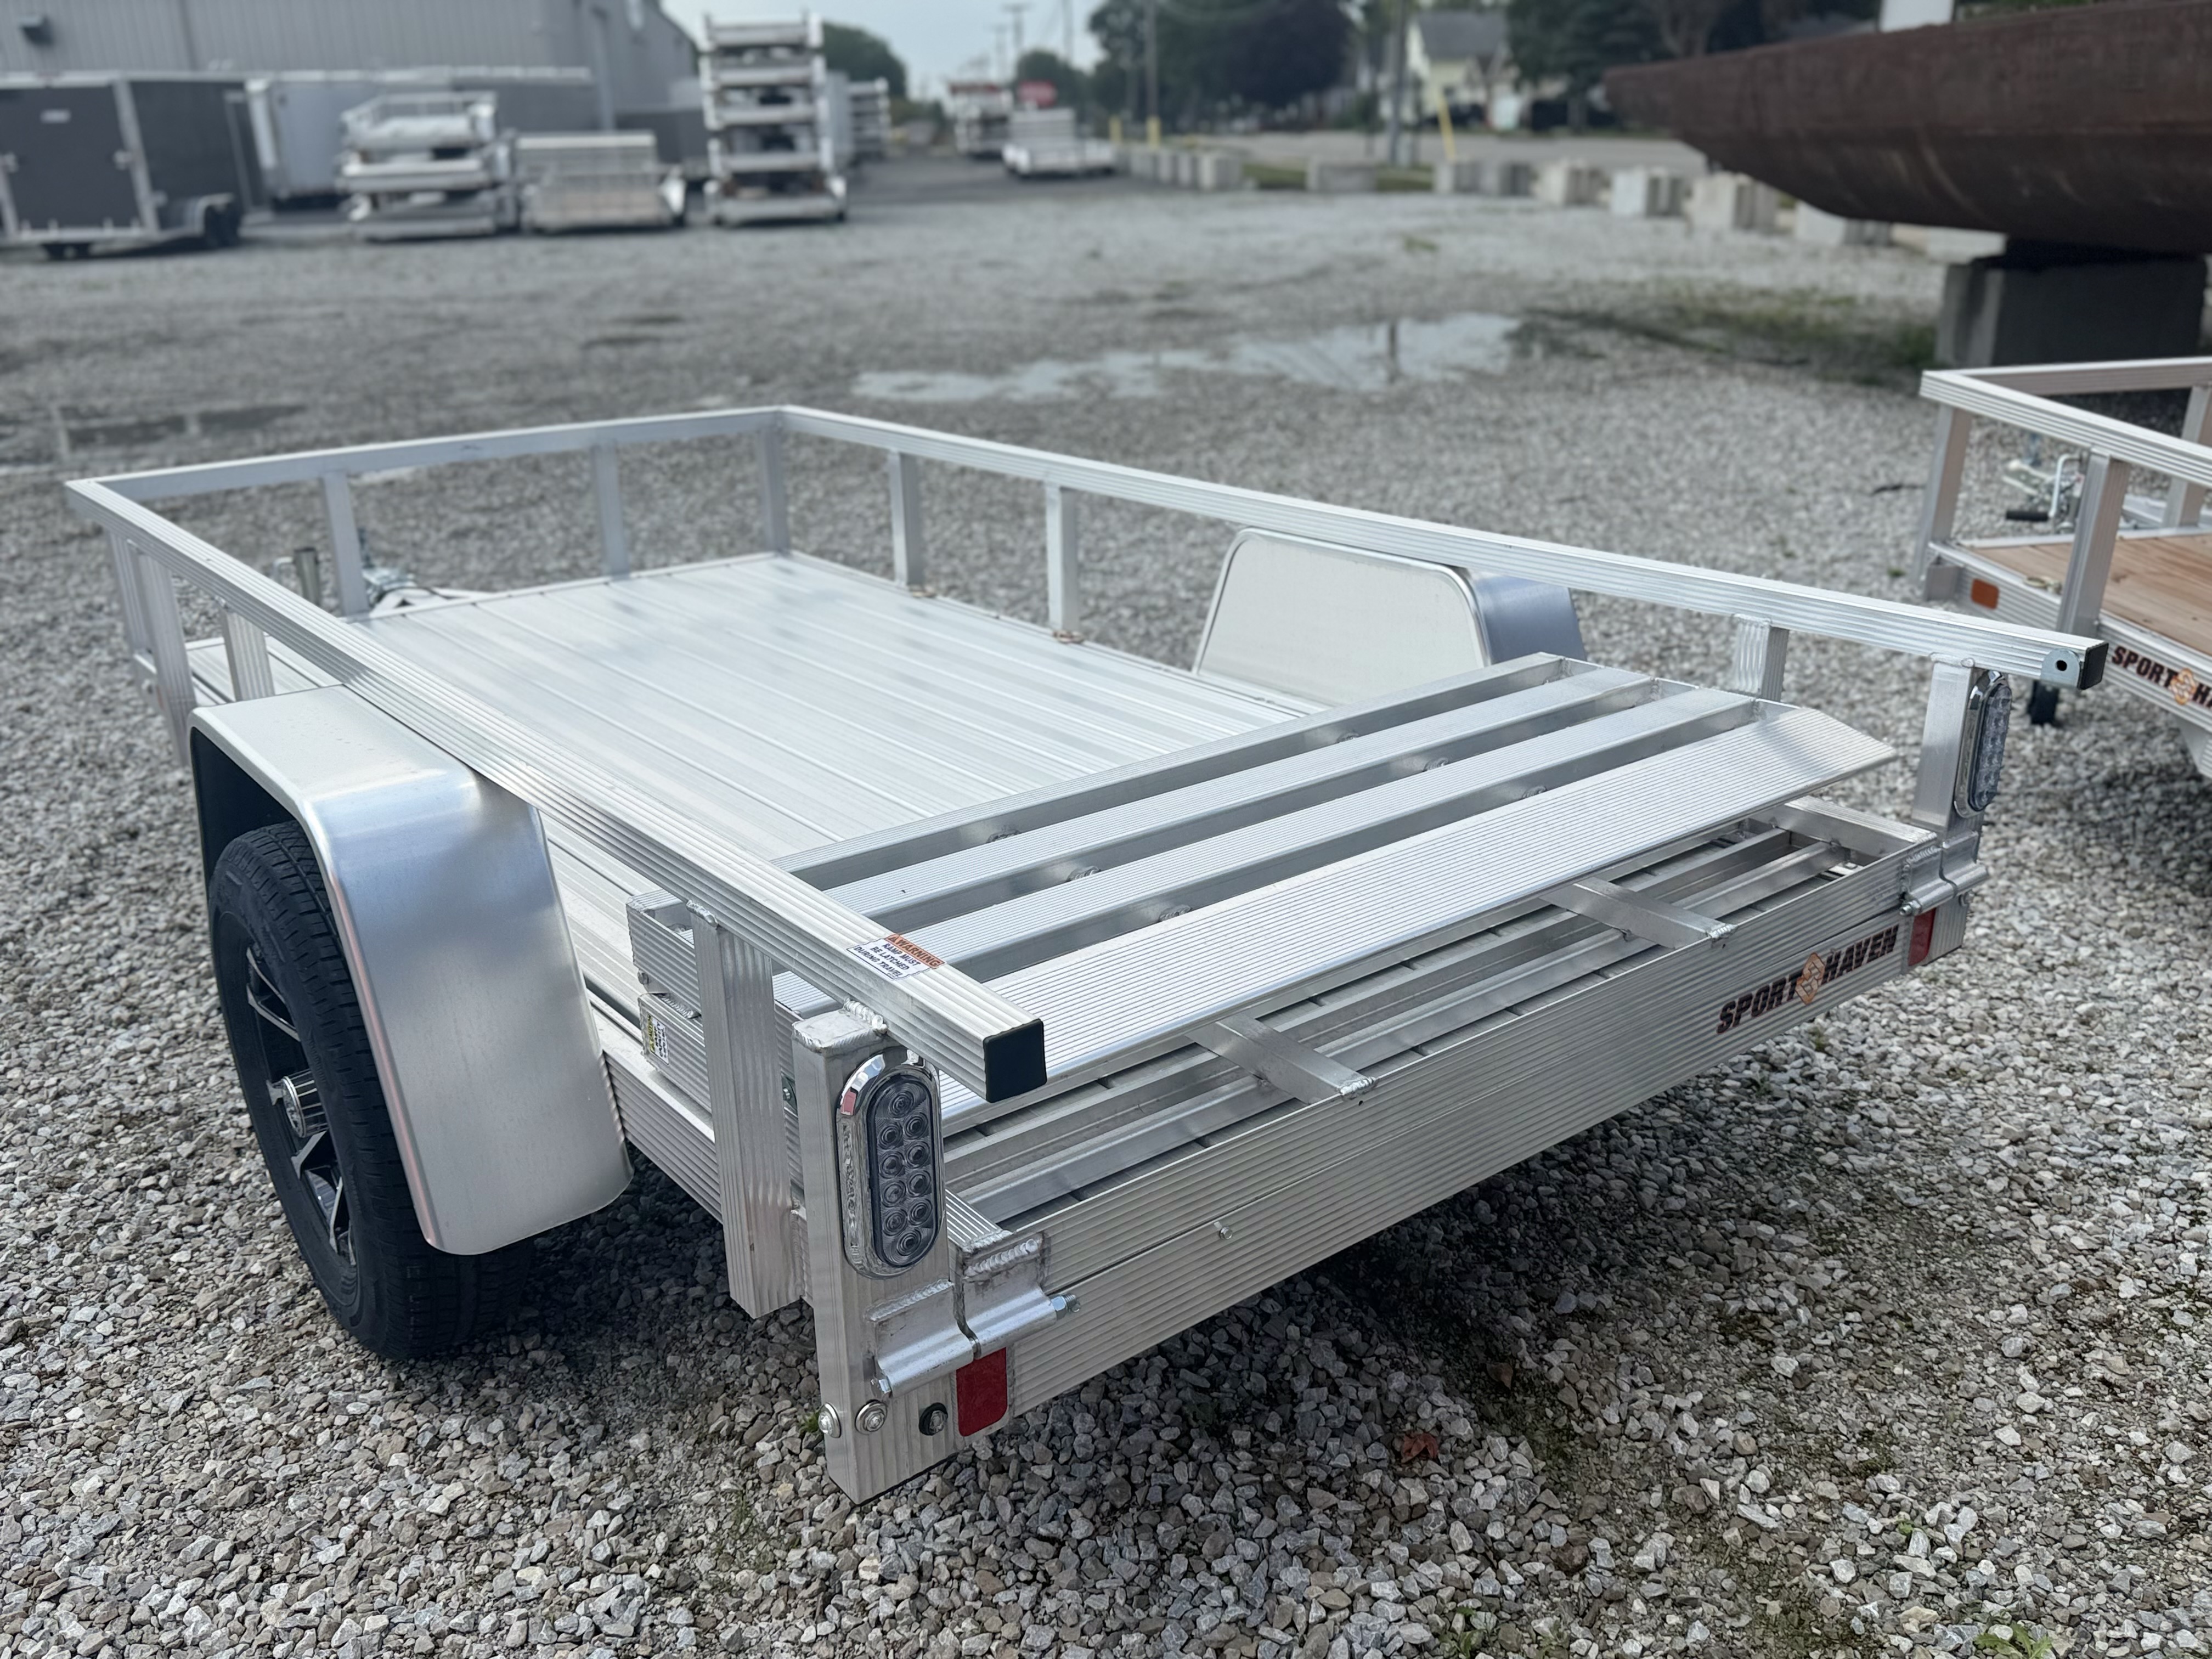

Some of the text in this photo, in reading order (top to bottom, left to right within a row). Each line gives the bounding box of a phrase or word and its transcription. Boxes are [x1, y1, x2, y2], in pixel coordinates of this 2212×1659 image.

[2112, 646, 2179, 688] SPORT
[853, 946, 903, 977] DURING TRAVEL
[878, 952, 910, 970] LATCHED
[882, 943, 921, 966] RAMP MUST
[895, 939, 940, 966] WARNING
[1716, 924, 1899, 1034] SPORT HAVEN
